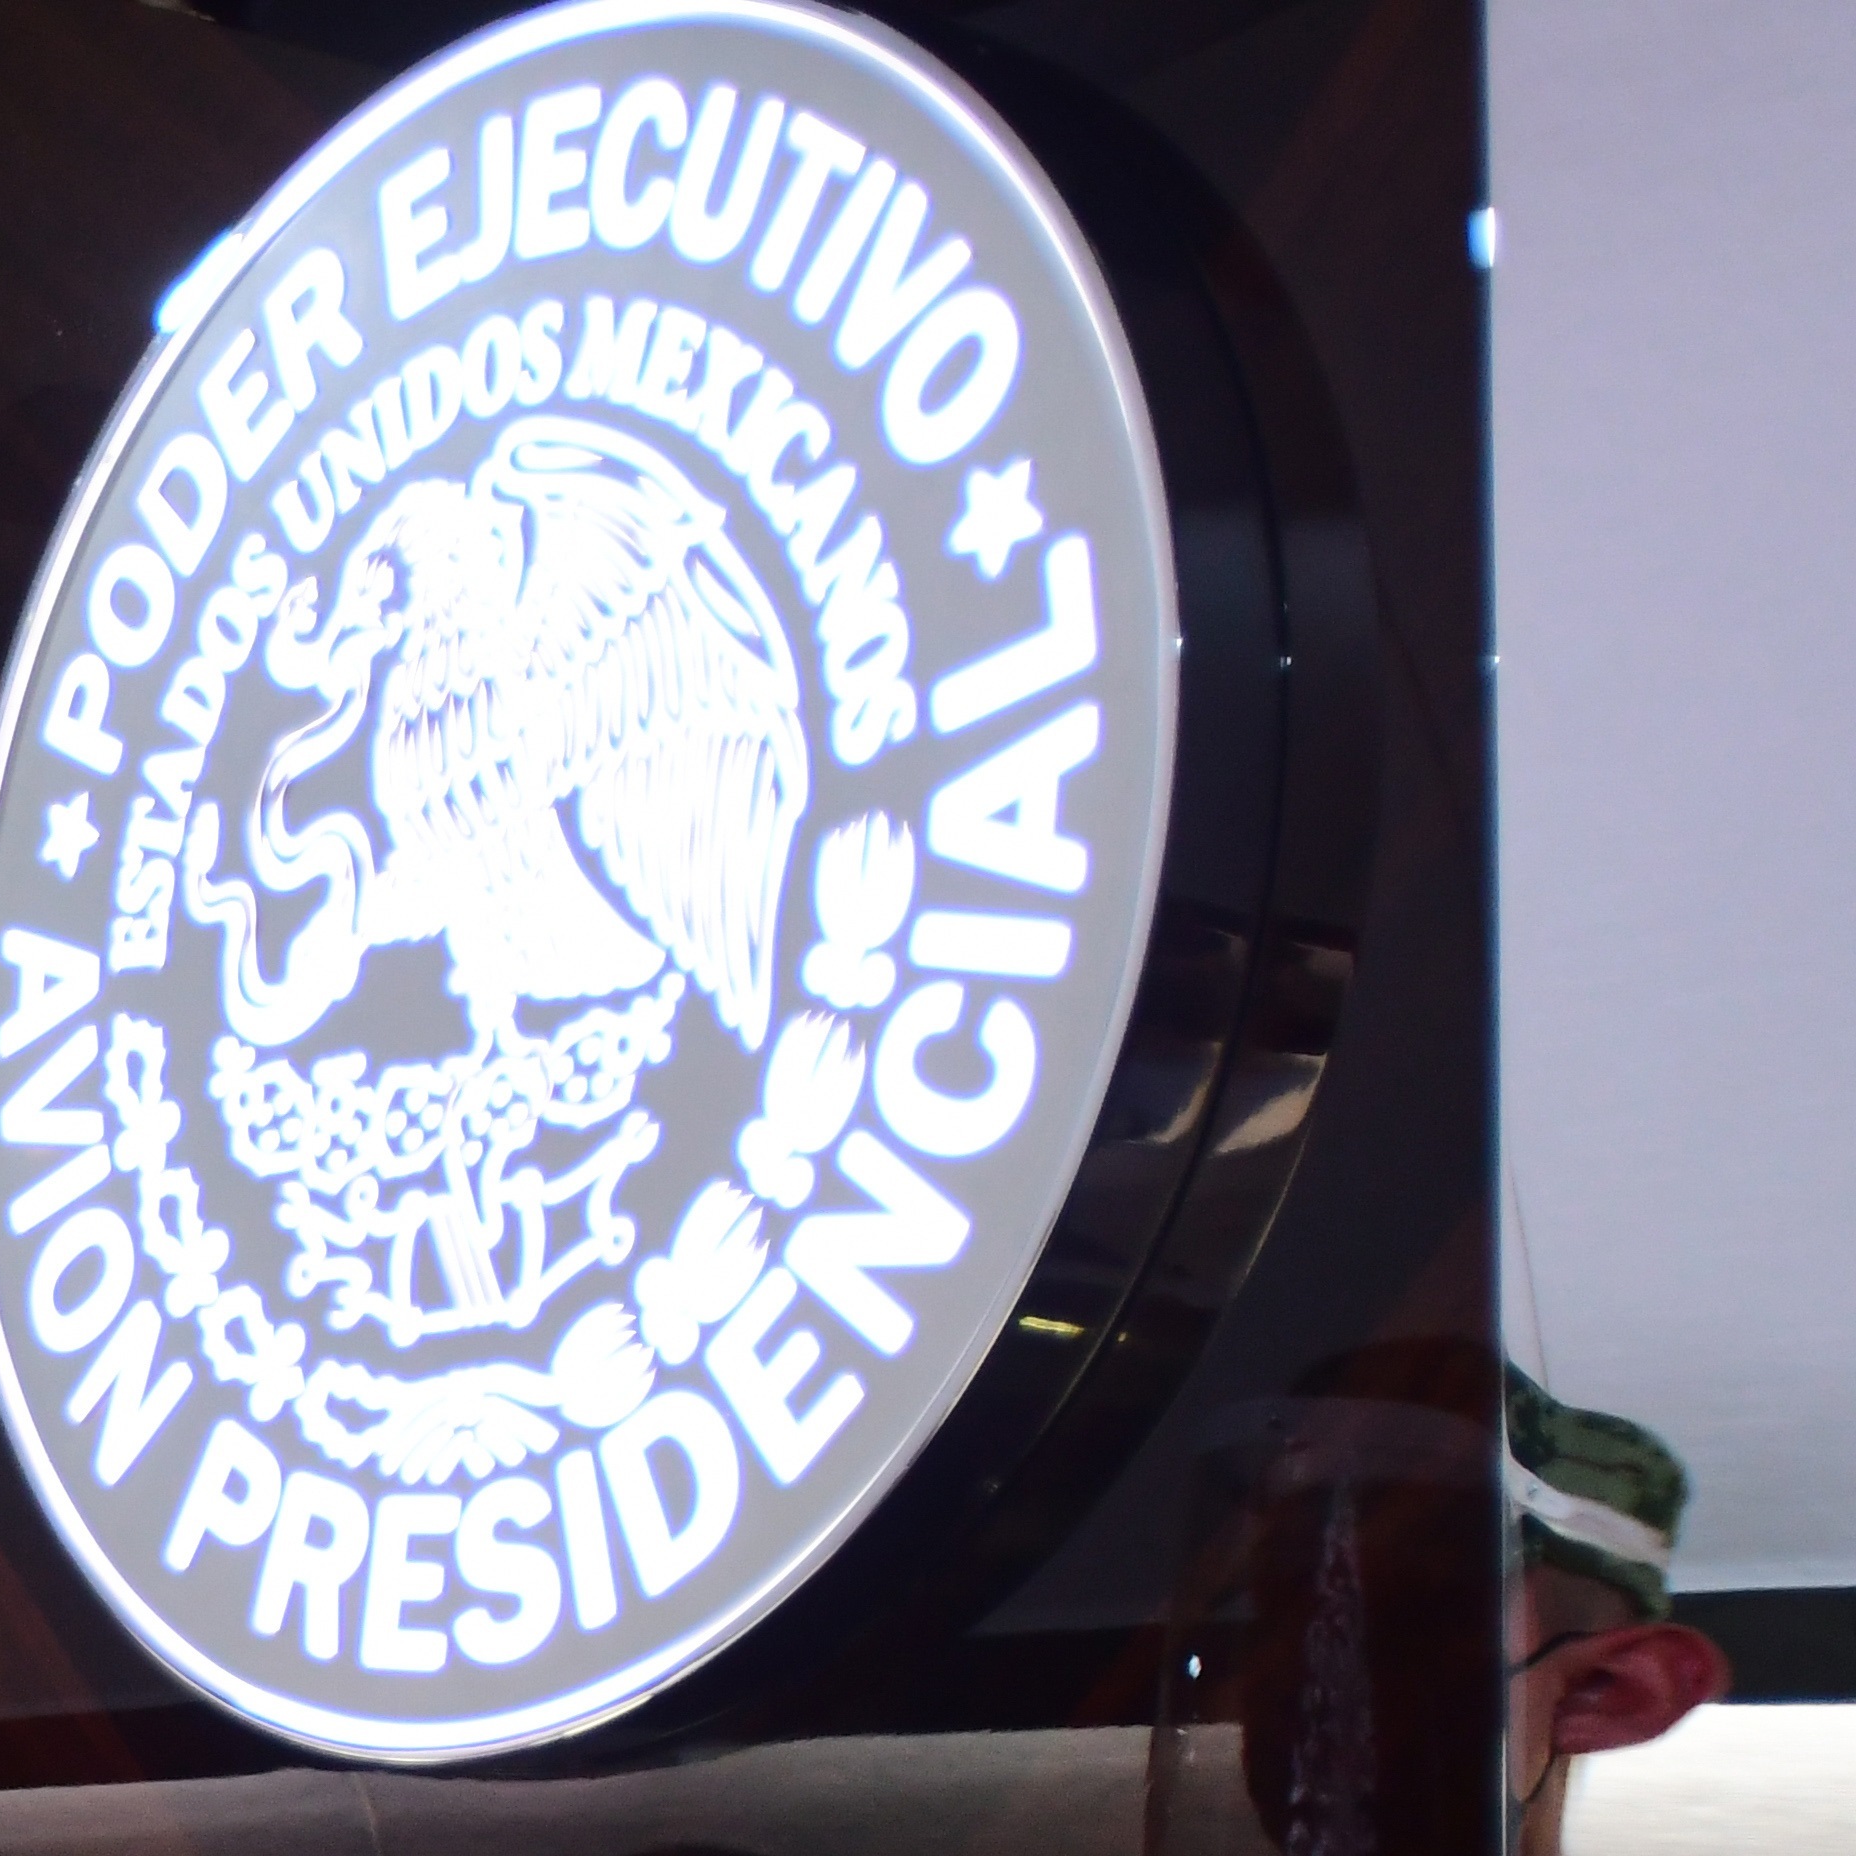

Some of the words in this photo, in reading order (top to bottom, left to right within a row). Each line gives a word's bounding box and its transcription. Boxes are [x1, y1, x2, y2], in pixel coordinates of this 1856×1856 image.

[42, 246, 367, 777] PODER
[378, 77, 1021, 464] EJECUTIVO
[107, 532, 289, 974] ESTADOS
[270, 298, 566, 556] UNIDOS
[562, 293, 920, 767] MEXICANOS
[164, 533, 1099, 1674] PRESIDENCIAL
